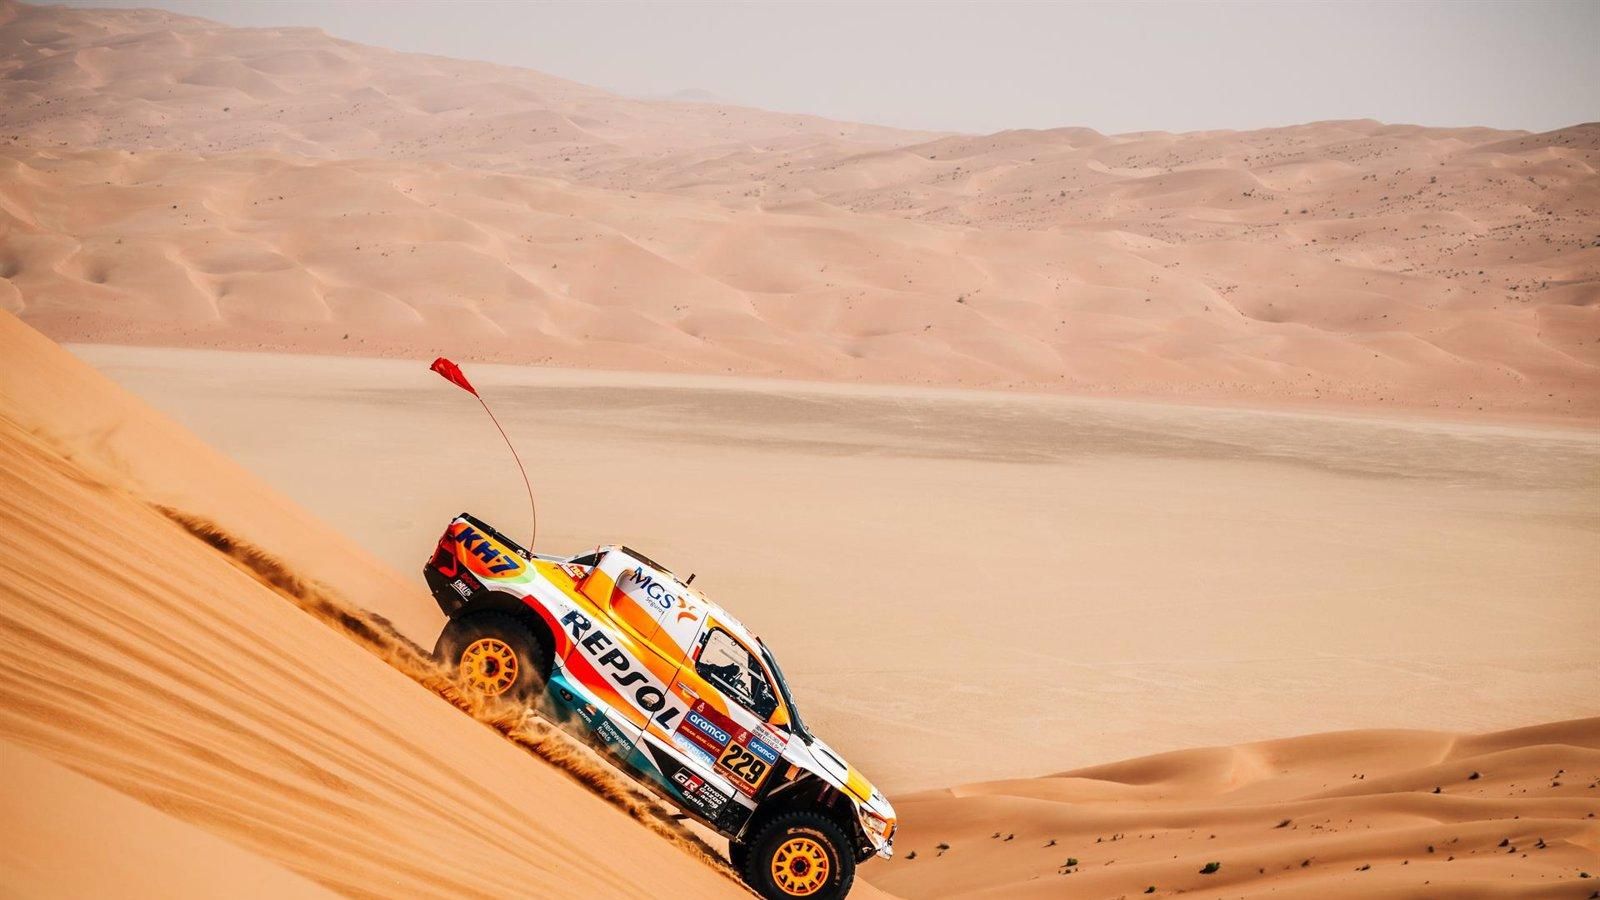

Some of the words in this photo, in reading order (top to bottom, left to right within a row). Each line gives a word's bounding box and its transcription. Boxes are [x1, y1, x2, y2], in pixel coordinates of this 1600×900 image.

[629, 566, 675, 609] MGS
[560, 609, 680, 730] REPSOL
[597, 726, 611, 742] fuels
[602, 720, 631, 751] Renewable
[690, 714, 726, 742] aramco
[750, 741, 776, 761] aramco
[720, 744, 766, 784] 229
[674, 773, 698, 792] GR
[682, 790, 705, 807] Spain
[696, 790, 719, 809] Racing
[703, 783, 727, 803] TOYOTA
